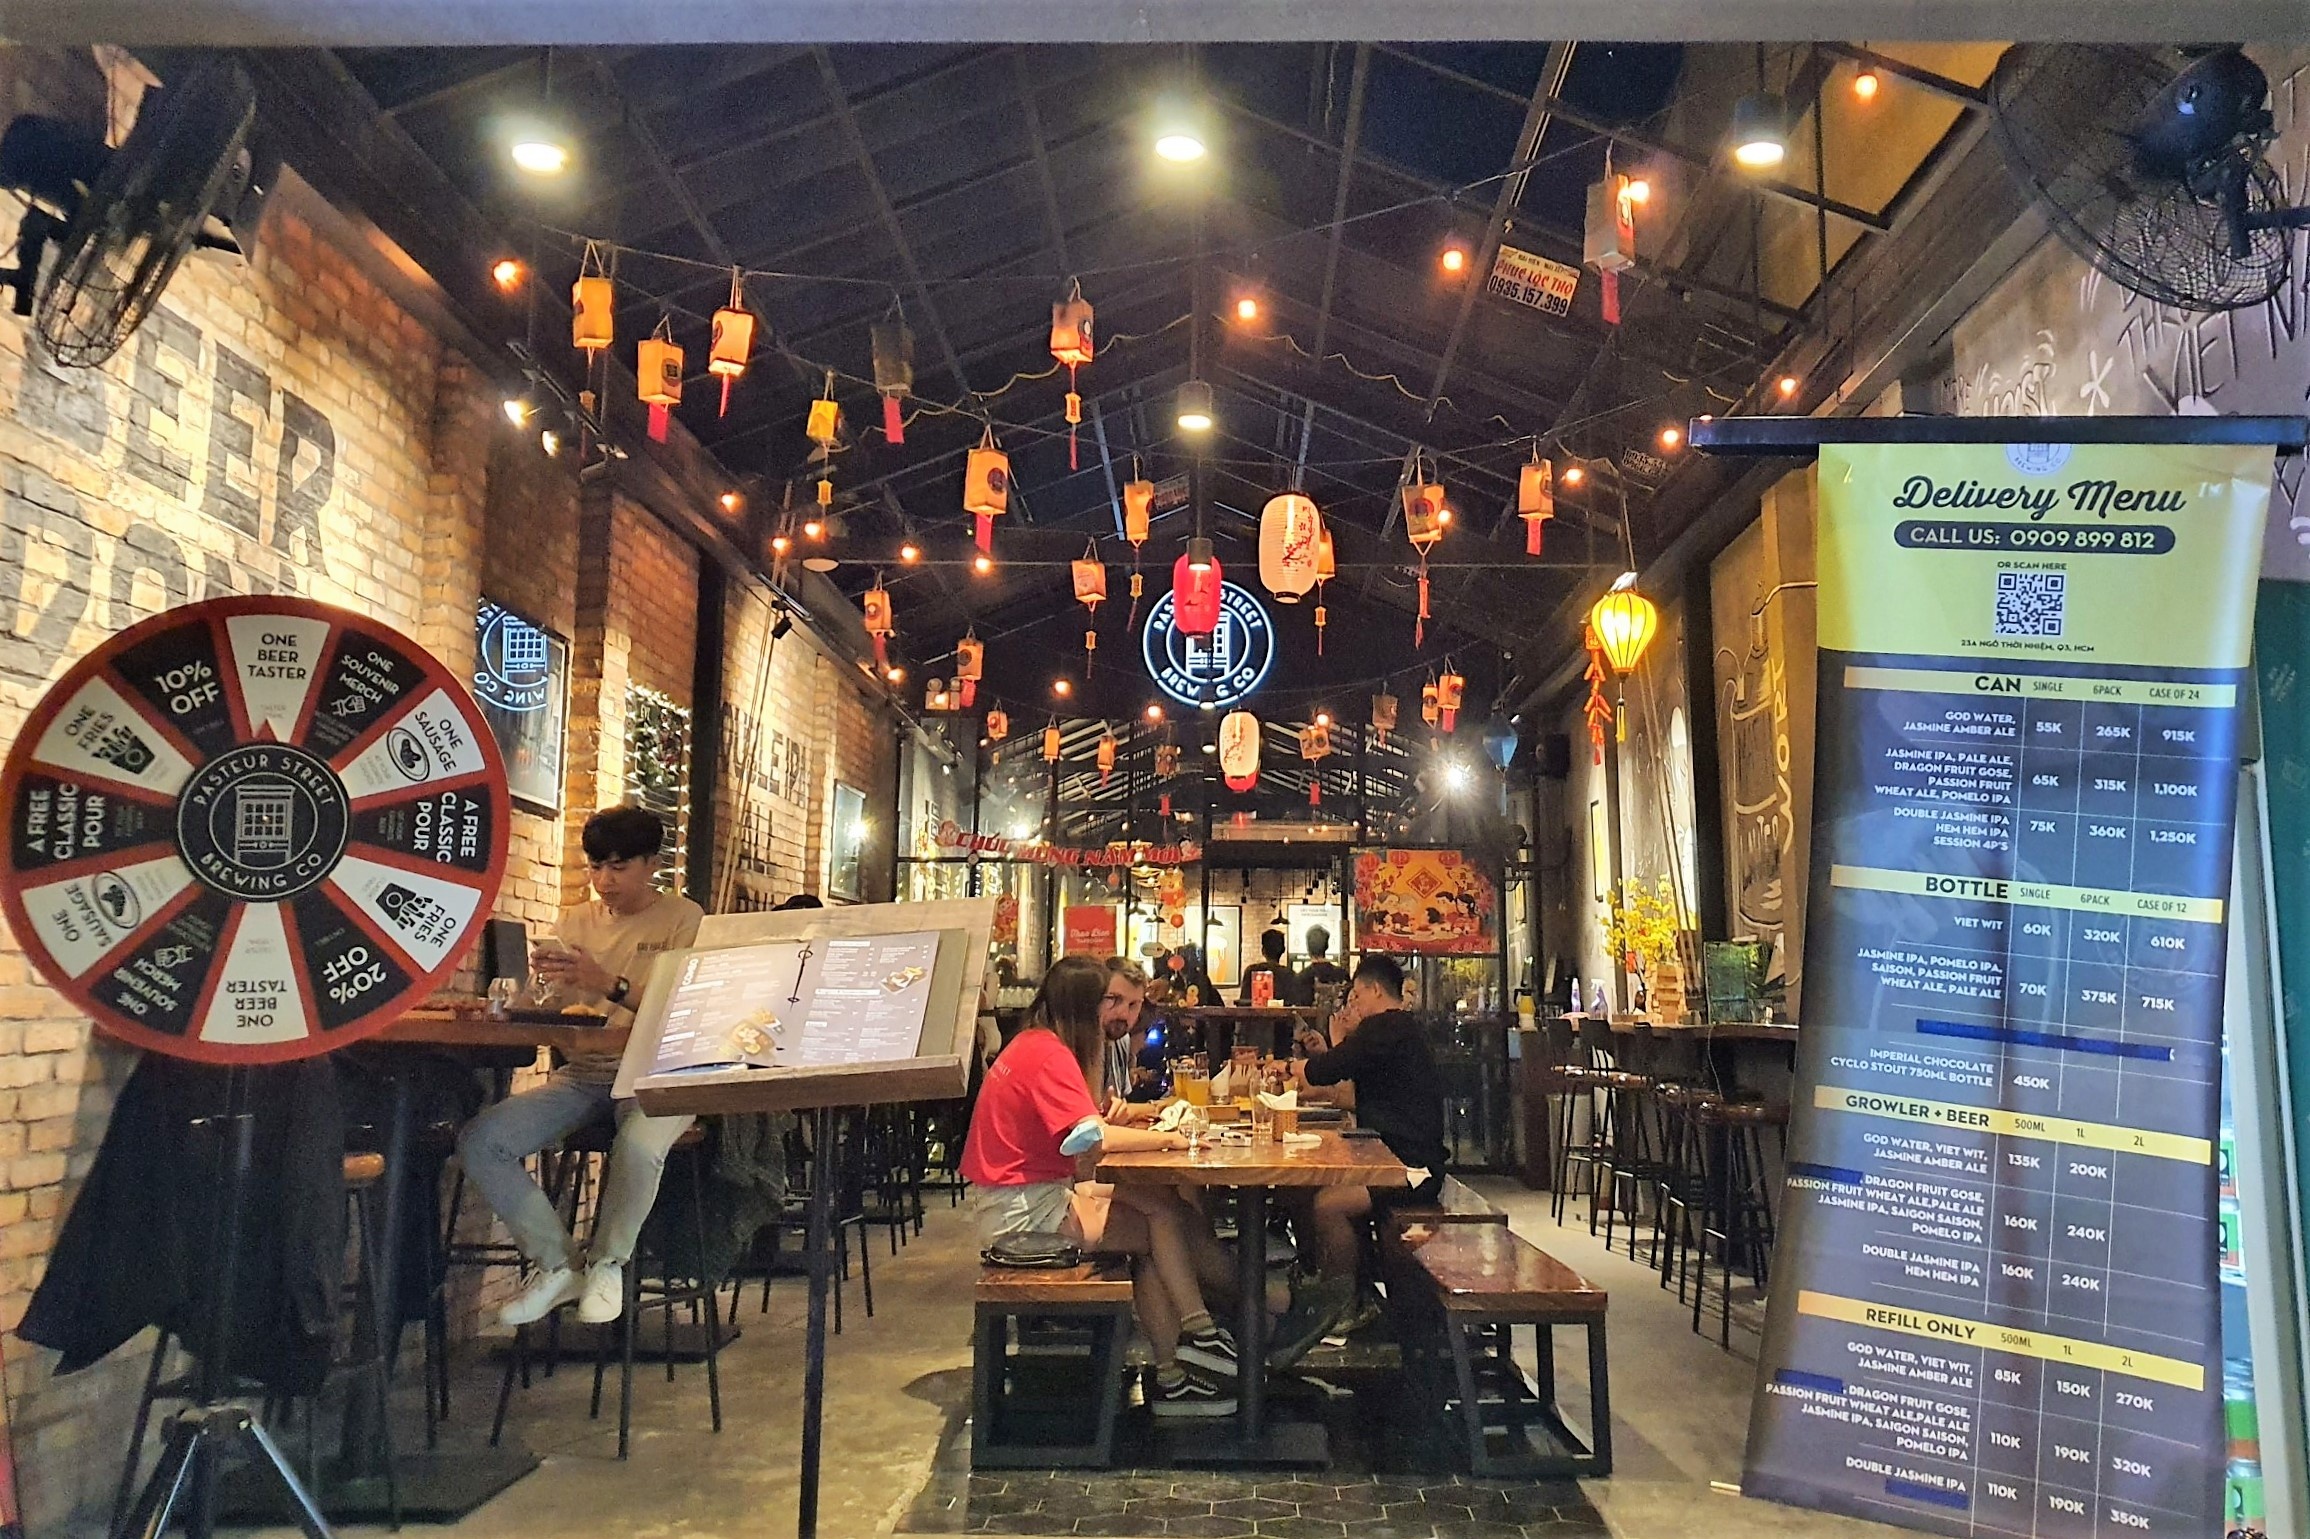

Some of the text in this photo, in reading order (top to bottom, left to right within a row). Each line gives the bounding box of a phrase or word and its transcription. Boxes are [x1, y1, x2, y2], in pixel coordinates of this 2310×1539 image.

[1488, 274, 1568, 315] 0935.157.399
[1893, 475, 2186, 521] Delivery Menu
[1910, 527, 2154, 548] CALL US: 0909 899 812
[2013, 561, 2039, 569] SCAN
[2041, 562, 2067, 570] HERE
[1220, 589, 1263, 629] STREET
[261, 633, 297, 647] ONE
[257, 650, 298, 663] BEER
[367, 651, 394, 673] ONE
[153, 660, 212, 695] 10%
[247, 664, 307, 680] TASTER
[341, 654, 400, 696] SOUVENIR
[338, 673, 383, 704] MERCH
[1160, 667, 1256, 698] BREWG CO
[1975, 675, 2021, 692] CAN
[2033, 681, 2063, 692] SINGLE
[2093, 684, 2122, 696] 6PACK
[170, 682, 220, 714] OFF
[2149, 687, 2199, 700] CASE OF 24
[65, 704, 97, 736] ONE
[1945, 711, 2016, 724] GOD WATER,
[77, 711, 116, 750] FRIES
[439, 718, 464, 750] ONE
[1903, 721, 2015, 737] JASMINE AMBER ALE
[2036, 721, 2061, 733] 55K
[2096, 725, 2130, 738] 265K
[2162, 729, 2195, 742] 915K
[414, 711, 457, 773] SAUSAGE
[1885, 747, 2013, 766] JASMINE IPA, PALE ALE,
[1894, 761, 2013, 778] DRAGON FRUIT GOSE,
[193, 754, 269, 806] PASTEUR
[281, 756, 335, 805] STREET
[1928, 776, 2012, 791] PASSION FRUIT
[2032, 774, 2059, 786] 65K
[2094, 778, 2126, 791] 315K
[27, 789, 50, 852] A FREE
[53, 783, 80, 860] CLASSIC
[82, 794, 106, 849] POUR
[1893, 806, 2010, 825] DOUBLE JASMINE IPA
[413, 801, 433, 850] POUR
[435, 792, 457, 864] CLASSIC
[460, 799, 479, 858] A FREE
[1935, 823, 2009, 838] HEM HEM IPA
[2030, 820, 2055, 832] 75K
[2089, 825, 2126, 838] 360K
[2150, 830, 2196, 844] 1,250K
[200, 852, 287, 889] BREWING
[296, 853, 322, 876] CO
[1925, 876, 2008, 899] BOTTLE
[2020, 887, 2050, 900] SINGLE
[2080, 893, 2110, 905] 6PACK
[2137, 898, 2187, 913] CASE OF 12
[65, 882, 113, 948] SAUSAGE
[414, 904, 446, 943] FRIES
[1954, 916, 2003, 930] VIET WIT
[52, 908, 80, 942] ONE
[430, 917, 457, 948] ONE
[2023, 923, 2051, 936] 60K
[2083, 928, 2120, 943] 320K
[2150, 936, 2185, 949] 610K
[322, 946, 368, 982] OFF
[226, 980, 287, 993] TASTER
[329, 961, 388, 1006] 20%
[2019, 982, 2047, 996] 70K
[116, 992, 148, 1015] ONE
[235, 997, 277, 1010] BEER
[2081, 989, 2117, 1004] 375K
[2141, 996, 2174, 1011] 715K
[237, 1015, 274, 1028] ONE
[1870, 1048, 1994, 1074] IMPERIAL CHOCOLATE
[1830, 1056, 1993, 1087] CYCLO STOUT 750ML BOTTLE
[2013, 1075, 2049, 1089] 450K
[1845, 1094, 1989, 1127] GROWLER BEER
[2014, 1118, 2045, 1132] 500ML
[2076, 1127, 2084, 1138] 1L
[2133, 1135, 2144, 1147] 2L
[2008, 1153, 2040, 1169] 135K
[2069, 1162, 2107, 1178] 200K
[2004, 1214, 2037, 1231] 160K
[2067, 1225, 2105, 1241] 240K
[1866, 1308, 1975, 1339] REFILL ONLY
[2000, 1332, 2031, 1348] 500ML
[1847, 1341, 1973, 1375] GOD WATER, VIET WIT,
[2063, 1344, 2072, 1355] 1L
[2121, 1355, 2133, 1367] 2L
[1994, 1369, 2021, 1384] 85K
[2056, 1380, 2090, 1398] 150K
[2116, 1392, 2153, 1411] 270K
[1990, 1431, 2020, 1449] 110K
[2054, 1445, 2089, 1463] 190K
[2112, 1457, 2151, 1478] 320K
